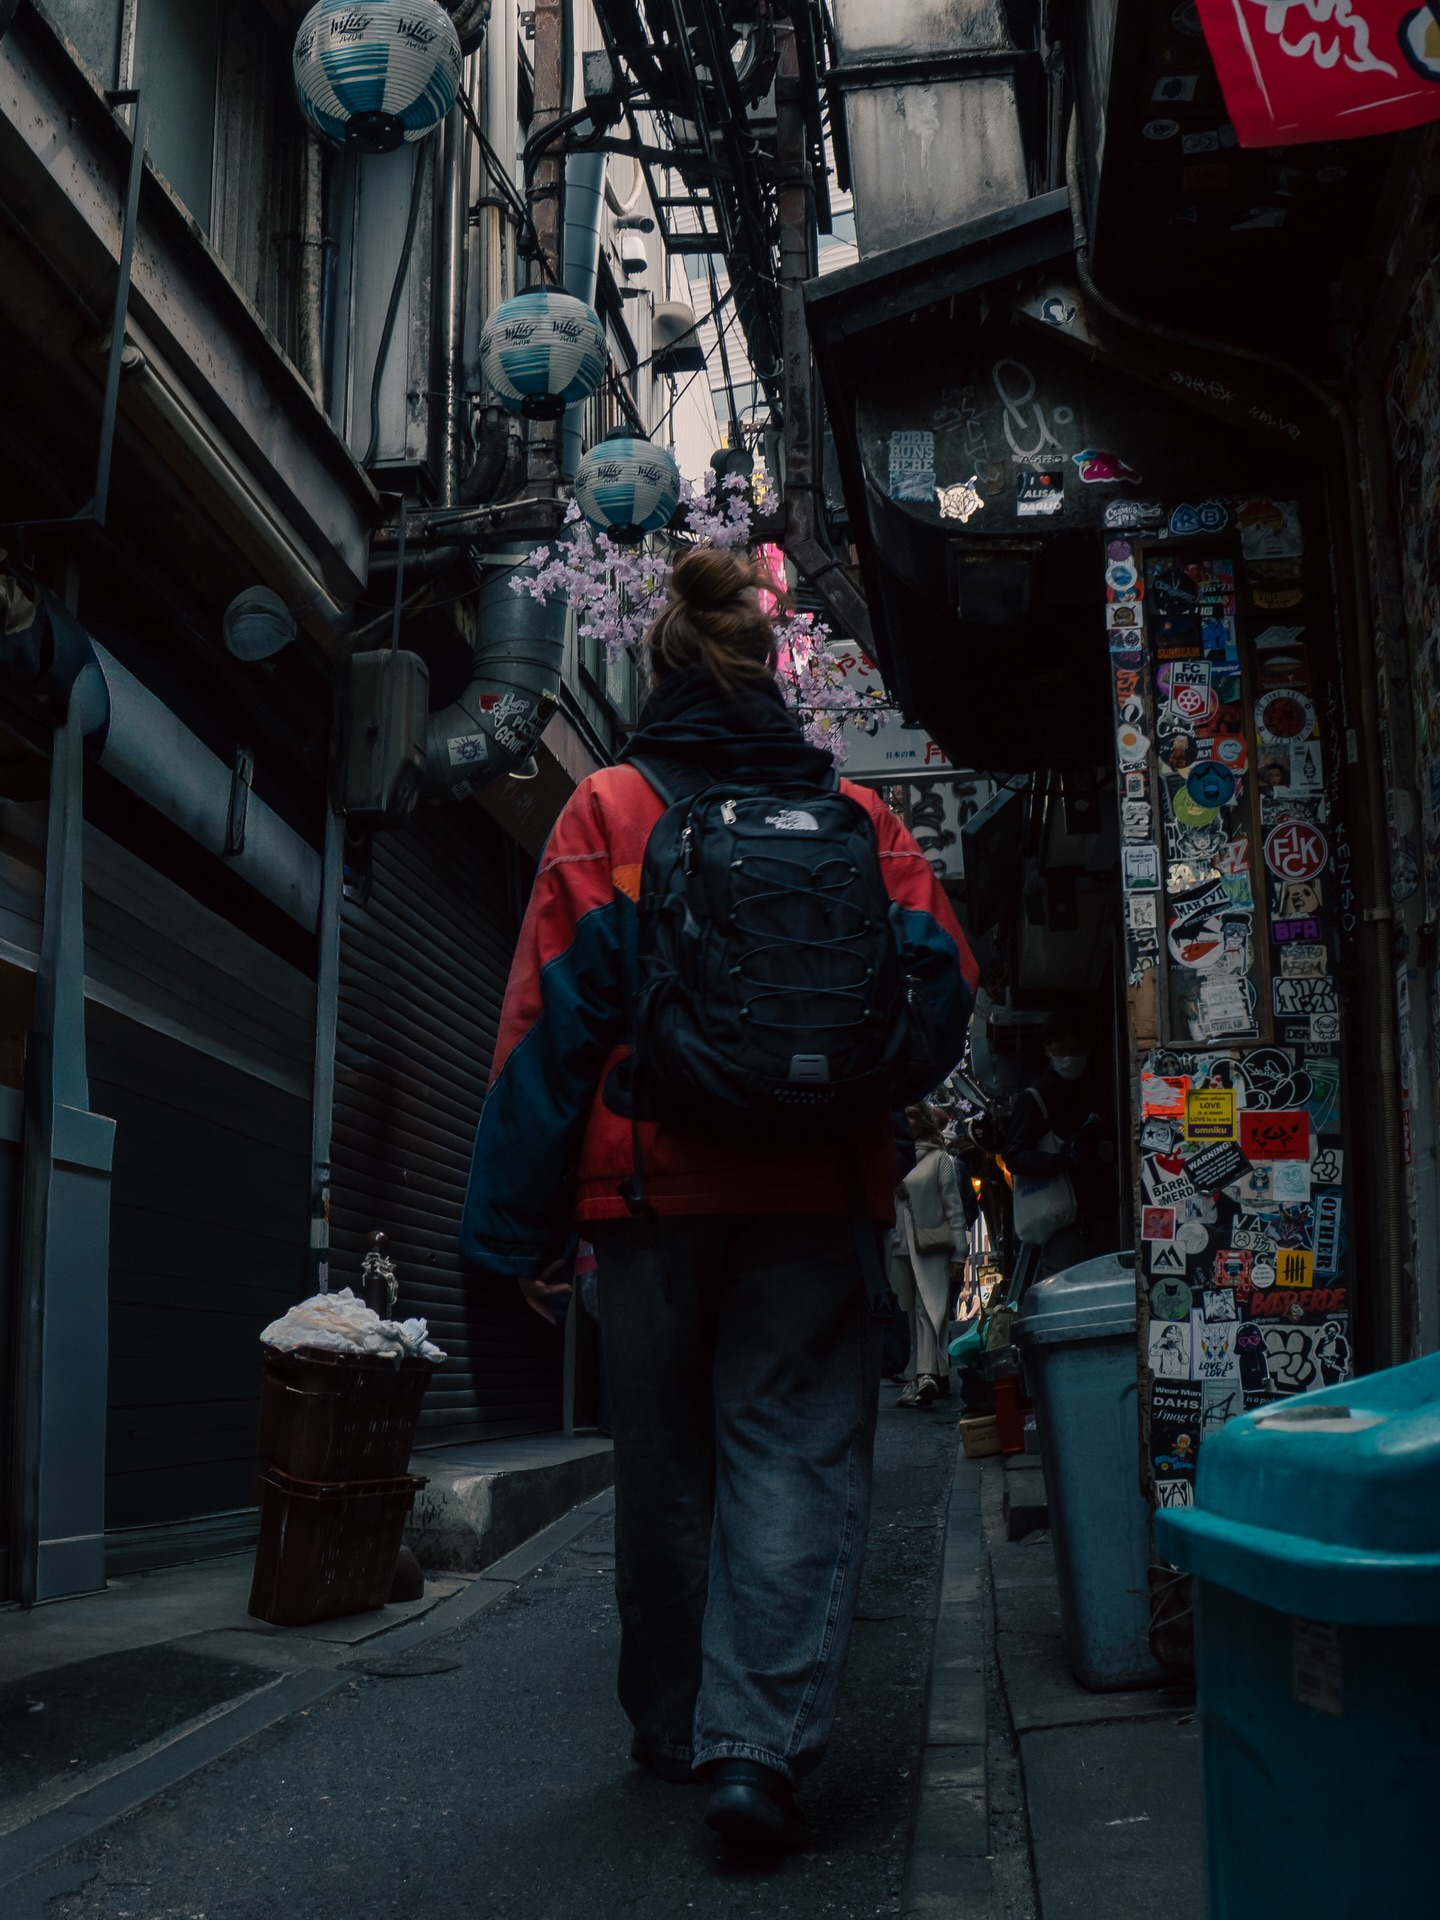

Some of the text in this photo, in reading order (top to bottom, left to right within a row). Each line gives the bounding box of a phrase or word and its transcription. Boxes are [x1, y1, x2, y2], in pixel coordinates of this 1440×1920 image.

[889, 444, 935, 459] RUNS
[888, 458, 935, 472] HERE
[1023, 489, 1056, 499] ALISA
[1182, 663, 1200, 674] FC
[1175, 673, 1207, 684] RWE
[886, 751, 916, 759] 日本の酒
[1194, 1126, 1228, 1135] omniku
[1187, 1141, 1233, 1171] WARNING:
[1199, 1361, 1234, 1370] LOVE IS
[1205, 1369, 1228, 1377] LOVE
[1155, 1386, 1180, 1395] Wear
[1153, 1396, 1201, 1410] DAHS
[1152, 1409, 1189, 1424] Smog
